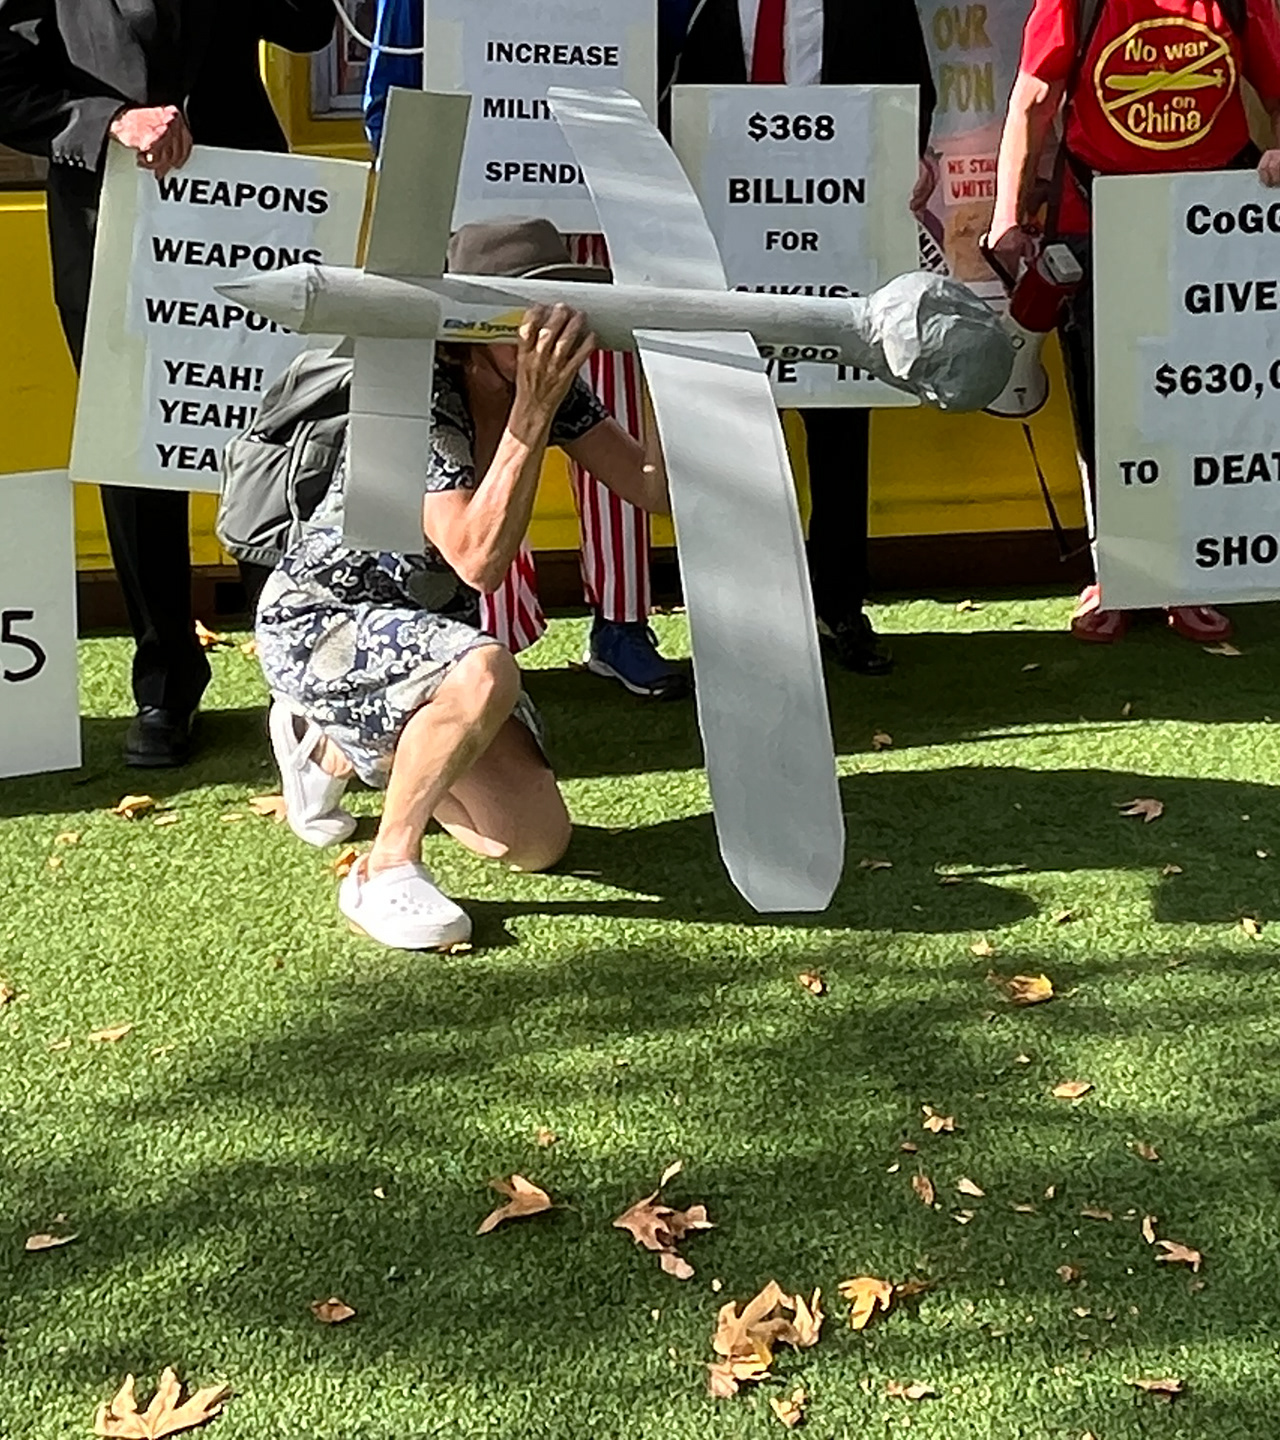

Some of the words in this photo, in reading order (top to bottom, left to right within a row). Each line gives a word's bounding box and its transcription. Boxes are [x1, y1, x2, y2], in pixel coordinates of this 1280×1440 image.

[486, 41, 619, 66] INCREASE
[1125, 37, 1156, 62] No
[1165, 40, 1208, 60] war
[1172, 96, 1195, 109] on
[747, 112, 835, 142] $368
[1127, 101, 1201, 133] China
[157, 176, 330, 214] WEAPONS
[728, 178, 866, 204] BILLION
[765, 231, 819, 251] FOR
[163, 360, 264, 392] YEAH!
[1119, 460, 1159, 485] TO
